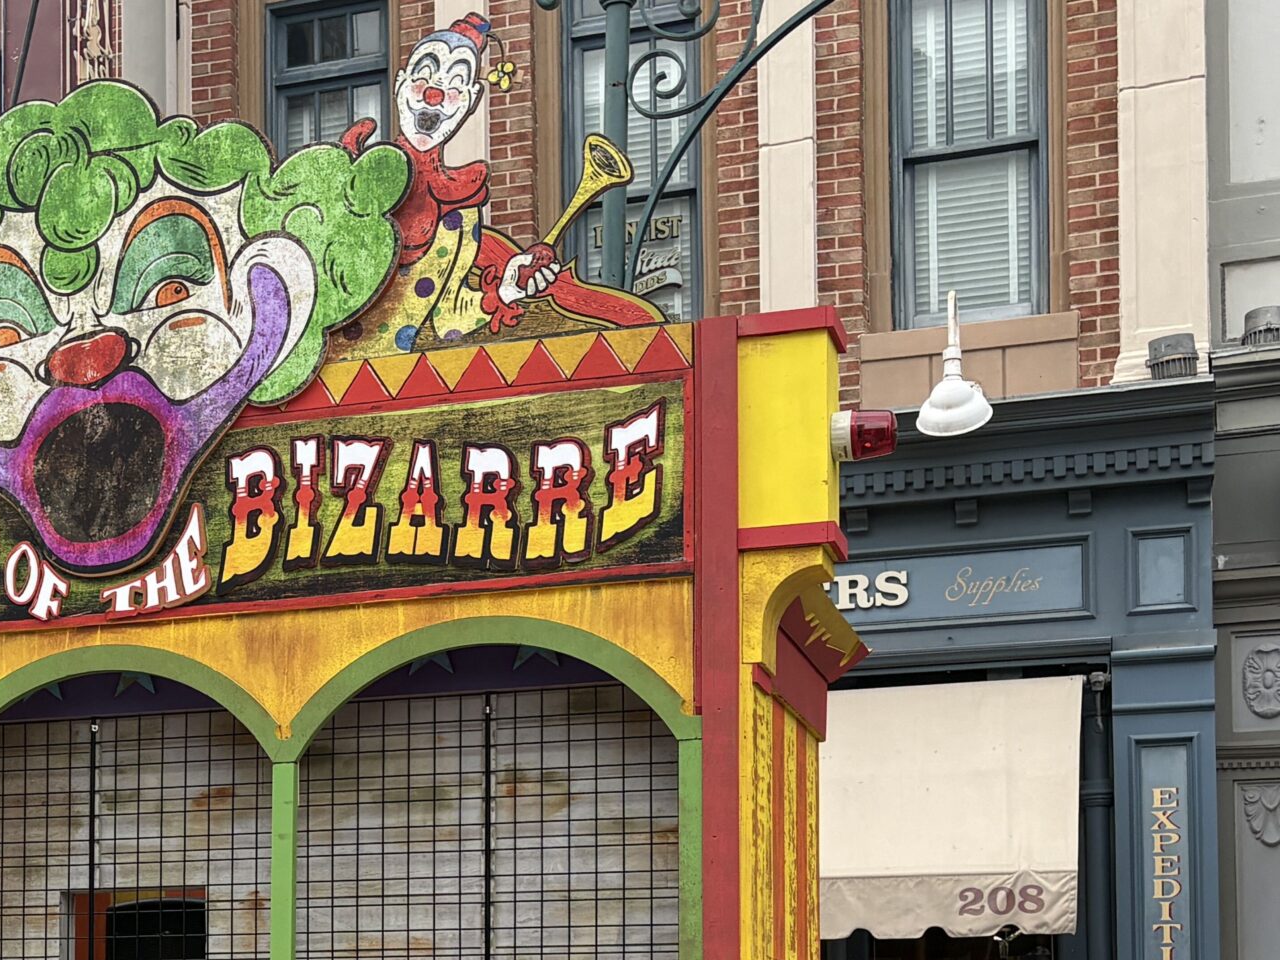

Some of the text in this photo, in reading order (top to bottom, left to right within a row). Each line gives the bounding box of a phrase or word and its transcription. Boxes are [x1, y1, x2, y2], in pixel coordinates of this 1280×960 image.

[4, 542, 72, 622] OF
[99, 502, 211, 621] THE
[217, 397, 665, 591] BIZARRE
[823, 570, 910, 611] RS
[944, 566, 1044, 607] Supplies
[958, 884, 1045, 917] 208
